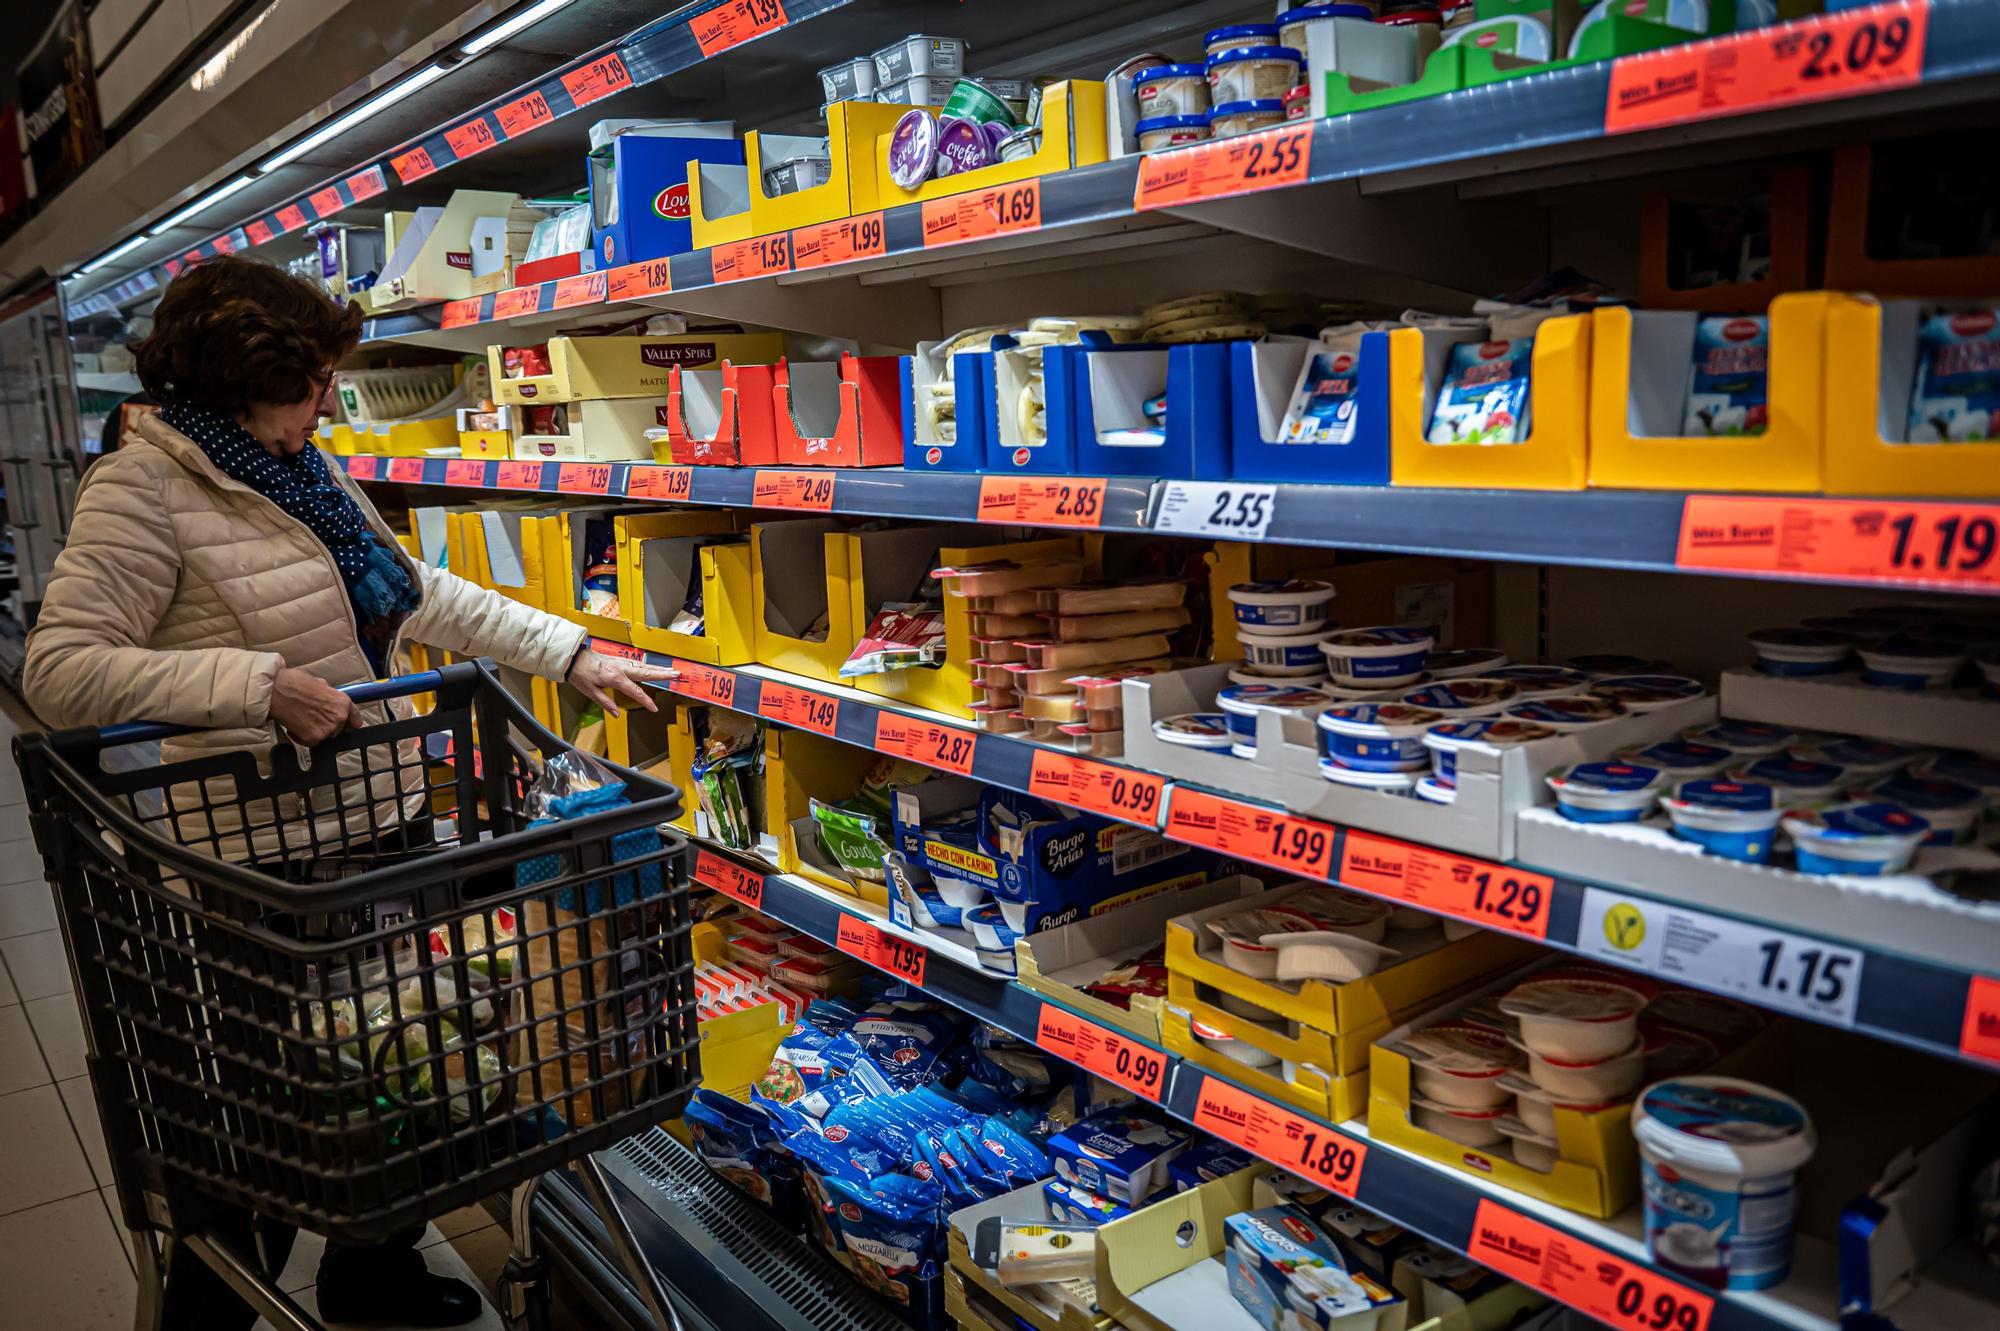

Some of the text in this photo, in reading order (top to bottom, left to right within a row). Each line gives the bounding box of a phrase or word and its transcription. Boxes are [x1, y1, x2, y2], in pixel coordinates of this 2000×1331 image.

[746, 0, 779, 27] 1.39
[1802, 17, 1911, 80] 2.09
[600, 58, 625, 86] 2.19
[526, 96, 547, 120] 2.29
[946, 142, 980, 166] crefée
[1244, 134, 1305, 179] 2.55
[663, 194, 689, 212] Lov
[997, 188, 1034, 226] 1.69
[926, 213, 957, 231] Més Barat
[851, 219, 881, 252] 1.99
[760, 237, 785, 269] 1.55
[647, 262, 668, 289] 1.89
[645, 347, 713, 360] VALLEY SPIRE
[524, 465, 540, 484] 2.75
[591, 468, 609, 489] 1.39
[667, 471, 690, 495] 1.39
[765, 484, 778, 493] Barat
[802, 478, 831, 503] 2.49
[998, 493, 1017, 503] Barat
[1055, 486, 1101, 517] 2.85
[1208, 491, 1270, 528] 2.55
[1889, 513, 1998, 571] 1.19
[711, 674, 733, 700] 1.99
[771, 696, 783, 705] Barat
[808, 698, 835, 727] 1.49
[891, 731, 906, 740] Barat
[936, 733, 973, 766] 2.87
[1035, 769, 1070, 783] Més Barat
[1111, 777, 1156, 813] 0.99
[1193, 812, 1217, 826] Barat
[927, 843, 949, 861] HECHO
[950, 850, 965, 866] CON
[1047, 832, 1085, 857] Burgo
[1271, 822, 1325, 865] 1.99
[1051, 849, 1084, 872] Arias
[736, 872, 760, 900] 2.89
[1473, 871, 1541, 922] 1.29
[1040, 907, 1078, 932] Burgo
[851, 932, 864, 942] Barat
[893, 942, 924, 977] 1.95
[1759, 938, 1853, 1002] 1.15
[1042, 1023, 1075, 1041] Més Barat
[1116, 1047, 1159, 1086] 0.99
[1203, 1100, 1246, 1122] Més Barat
[1300, 1132, 1357, 1182] 1.89
[857, 1242, 899, 1263] MOZZARELLA
[1617, 1279, 1700, 1331] 0.99
